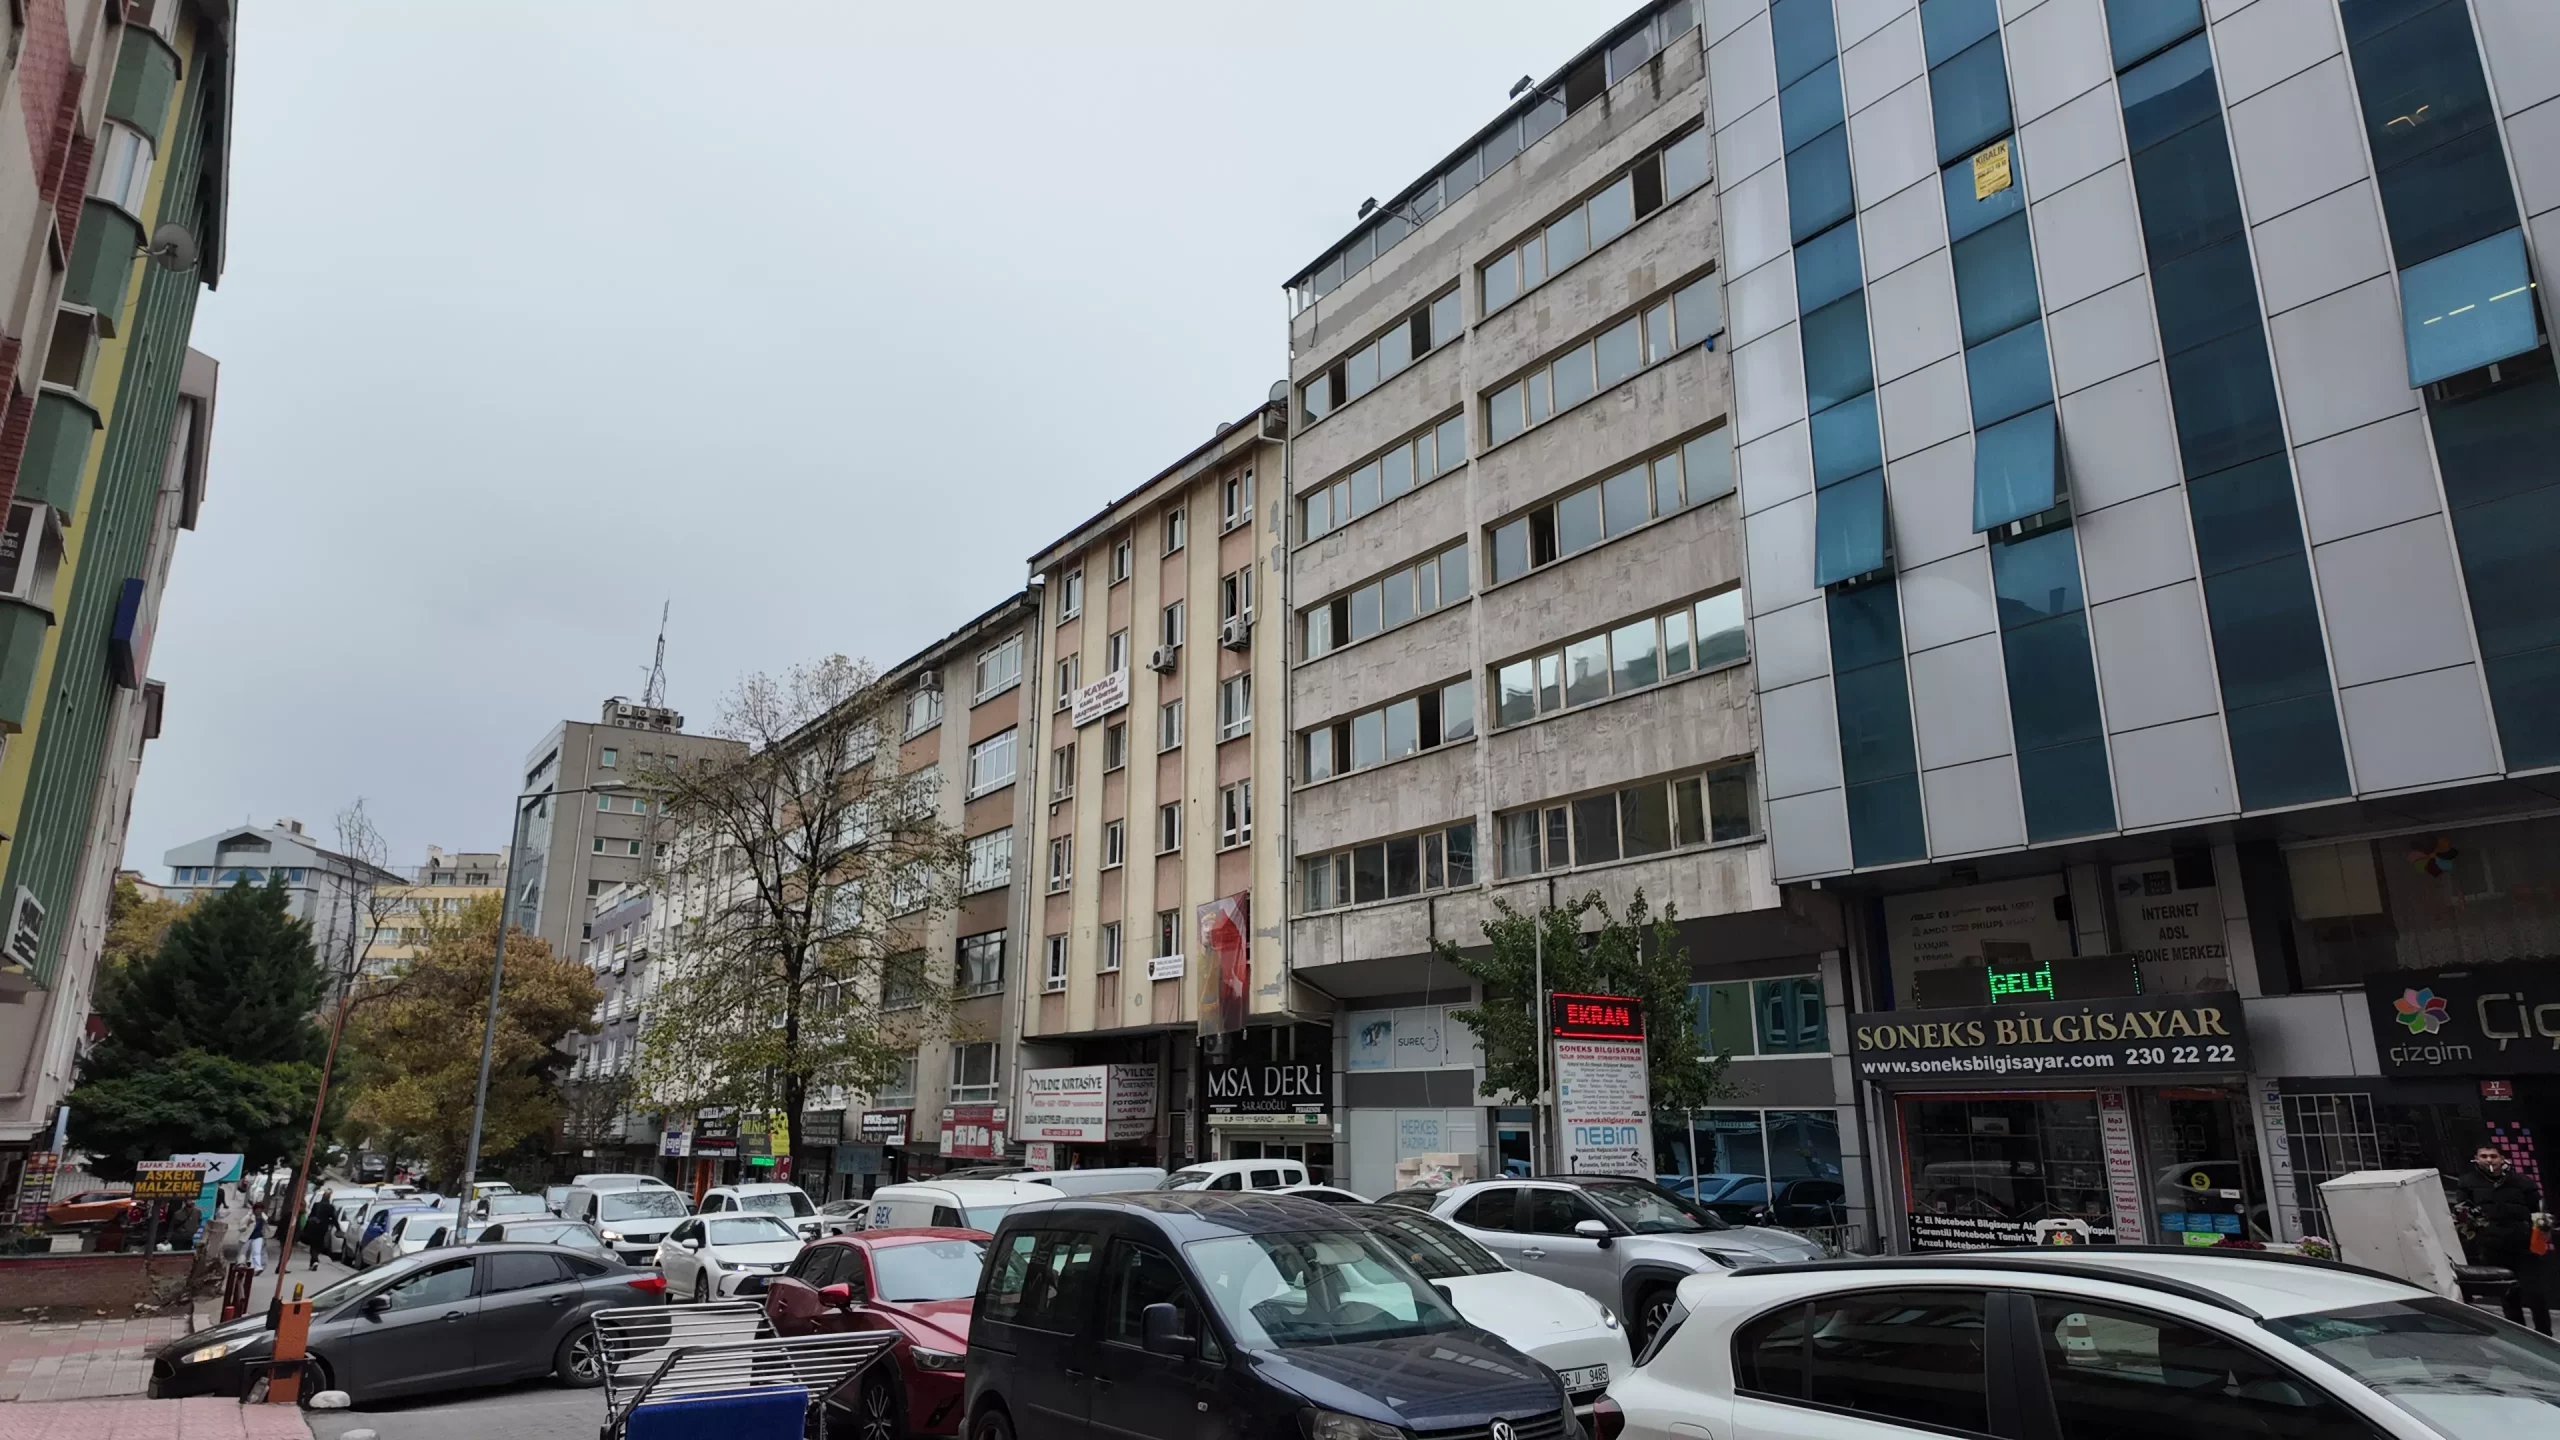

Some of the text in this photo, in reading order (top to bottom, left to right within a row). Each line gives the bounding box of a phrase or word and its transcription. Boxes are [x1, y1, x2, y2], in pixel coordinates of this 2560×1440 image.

[1975, 143, 2006, 166] KIRALIK
[1986, 904, 2008, 913] DELL
[2141, 903, 2199, 920] İNTERNET
[1971, 920, 2003, 931] PHILIPS
[2159, 926, 2189, 940] ADSL
[2136, 941, 2226, 963] BONE MERKEZİ
[1566, 1004, 1630, 1026] EKRAN
[1857, 1006, 2231, 1052] SONEKS BİLGİSAYAR
[1559, 1045, 1641, 1054] SONEKS BİLGİSAYAR
[2389, 1041, 2473, 1067] çizgim
[1861, 1044, 2236, 1075] www.soneksbilgisayar.com 230 22 22
[1124, 1068, 1156, 1077] YILDIZ
[1034, 1074, 1103, 1091] YILDIZ KIRTASİYE
[1208, 1064, 1323, 1097] MSA DERİ
[1118, 1122, 1145, 1130] TONER
[1402, 1119, 1438, 1134] HERKES
[2110, 1157, 2132, 1166] Pcler
[135, 1181, 201, 1193] MALZEME
[2195, 1175, 2206, 1186] S
[1915, 1215, 1924, 1224] 2.
[1924, 1216, 1934, 1225] El
[1934, 1216, 1976, 1227] Notebook
[1977, 1219, 2020, 1231] Bilgisayar
[2121, 1216, 2135, 1226] Boş
[1916, 1227, 1952, 1238] Garantili
[1953, 1229, 1995, 1240] Notebook
[1998, 1231, 2024, 1242] Tamiri
[1918, 1237, 1944, 1248] Arızalı
[1575, 1371, 1581, 1384] U
[1589, 1367, 1608, 1383] 9485
